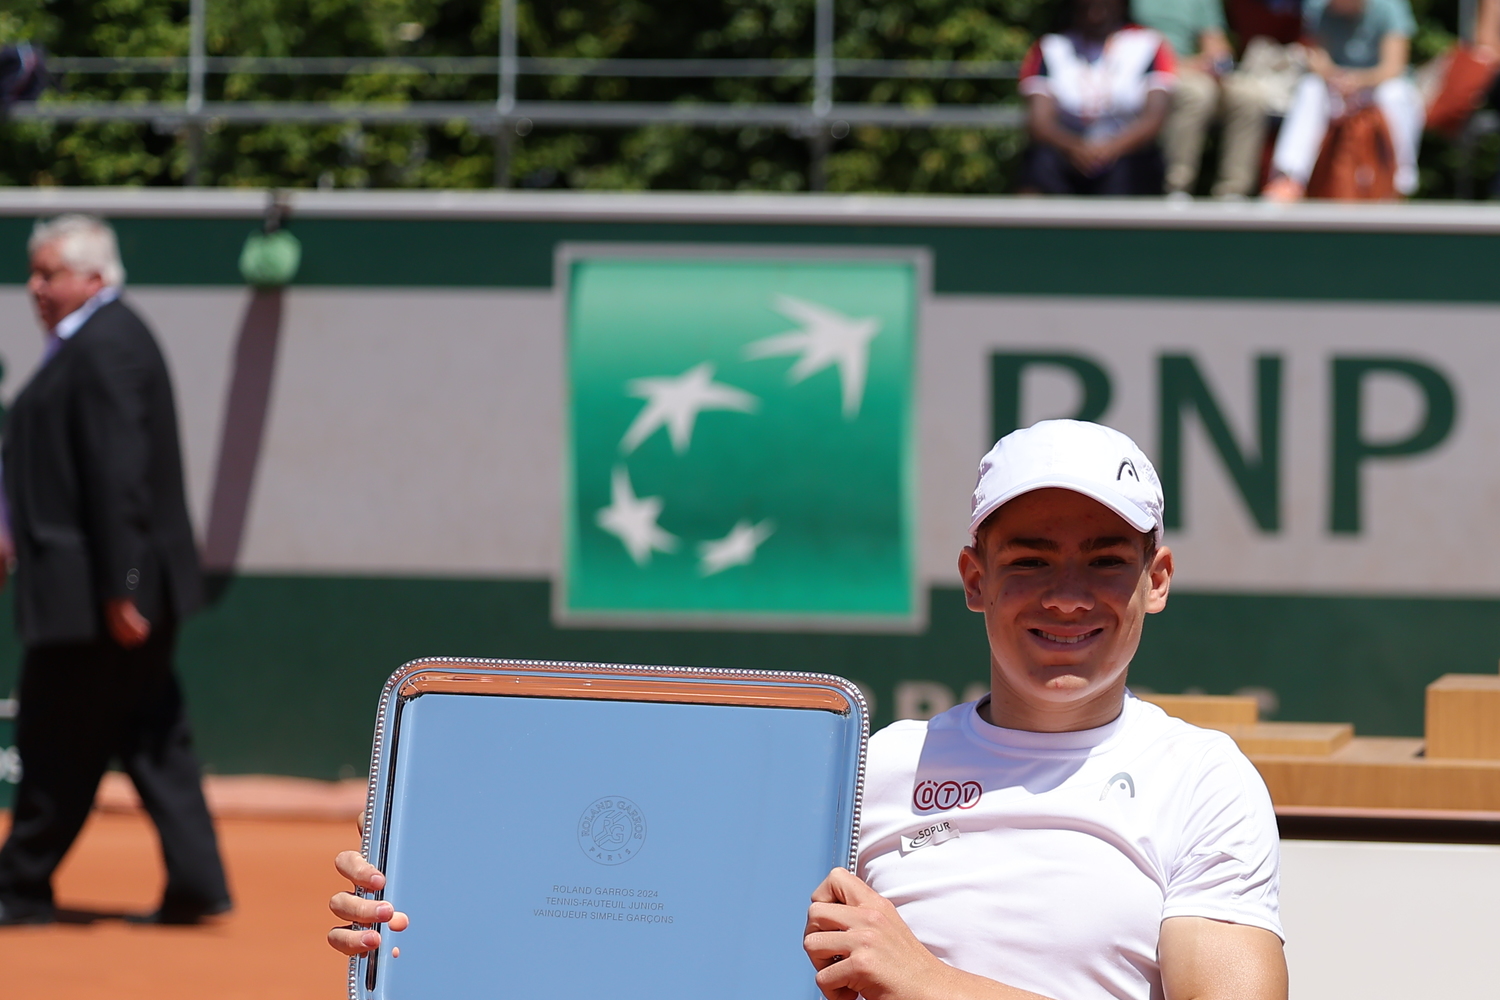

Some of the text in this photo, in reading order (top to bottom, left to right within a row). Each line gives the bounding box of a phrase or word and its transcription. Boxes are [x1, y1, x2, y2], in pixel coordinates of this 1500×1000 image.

[918, 821, 951, 839] SOPUR
[588, 846, 631, 861] PARIS
[552, 885, 658, 898] ROLAND GARROS 2024
[546, 896, 664, 911] TENNIS-FAUTEUIL JUNIOR
[533, 909, 674, 924] VAINQUEUR SIMPLE GARÇONS
